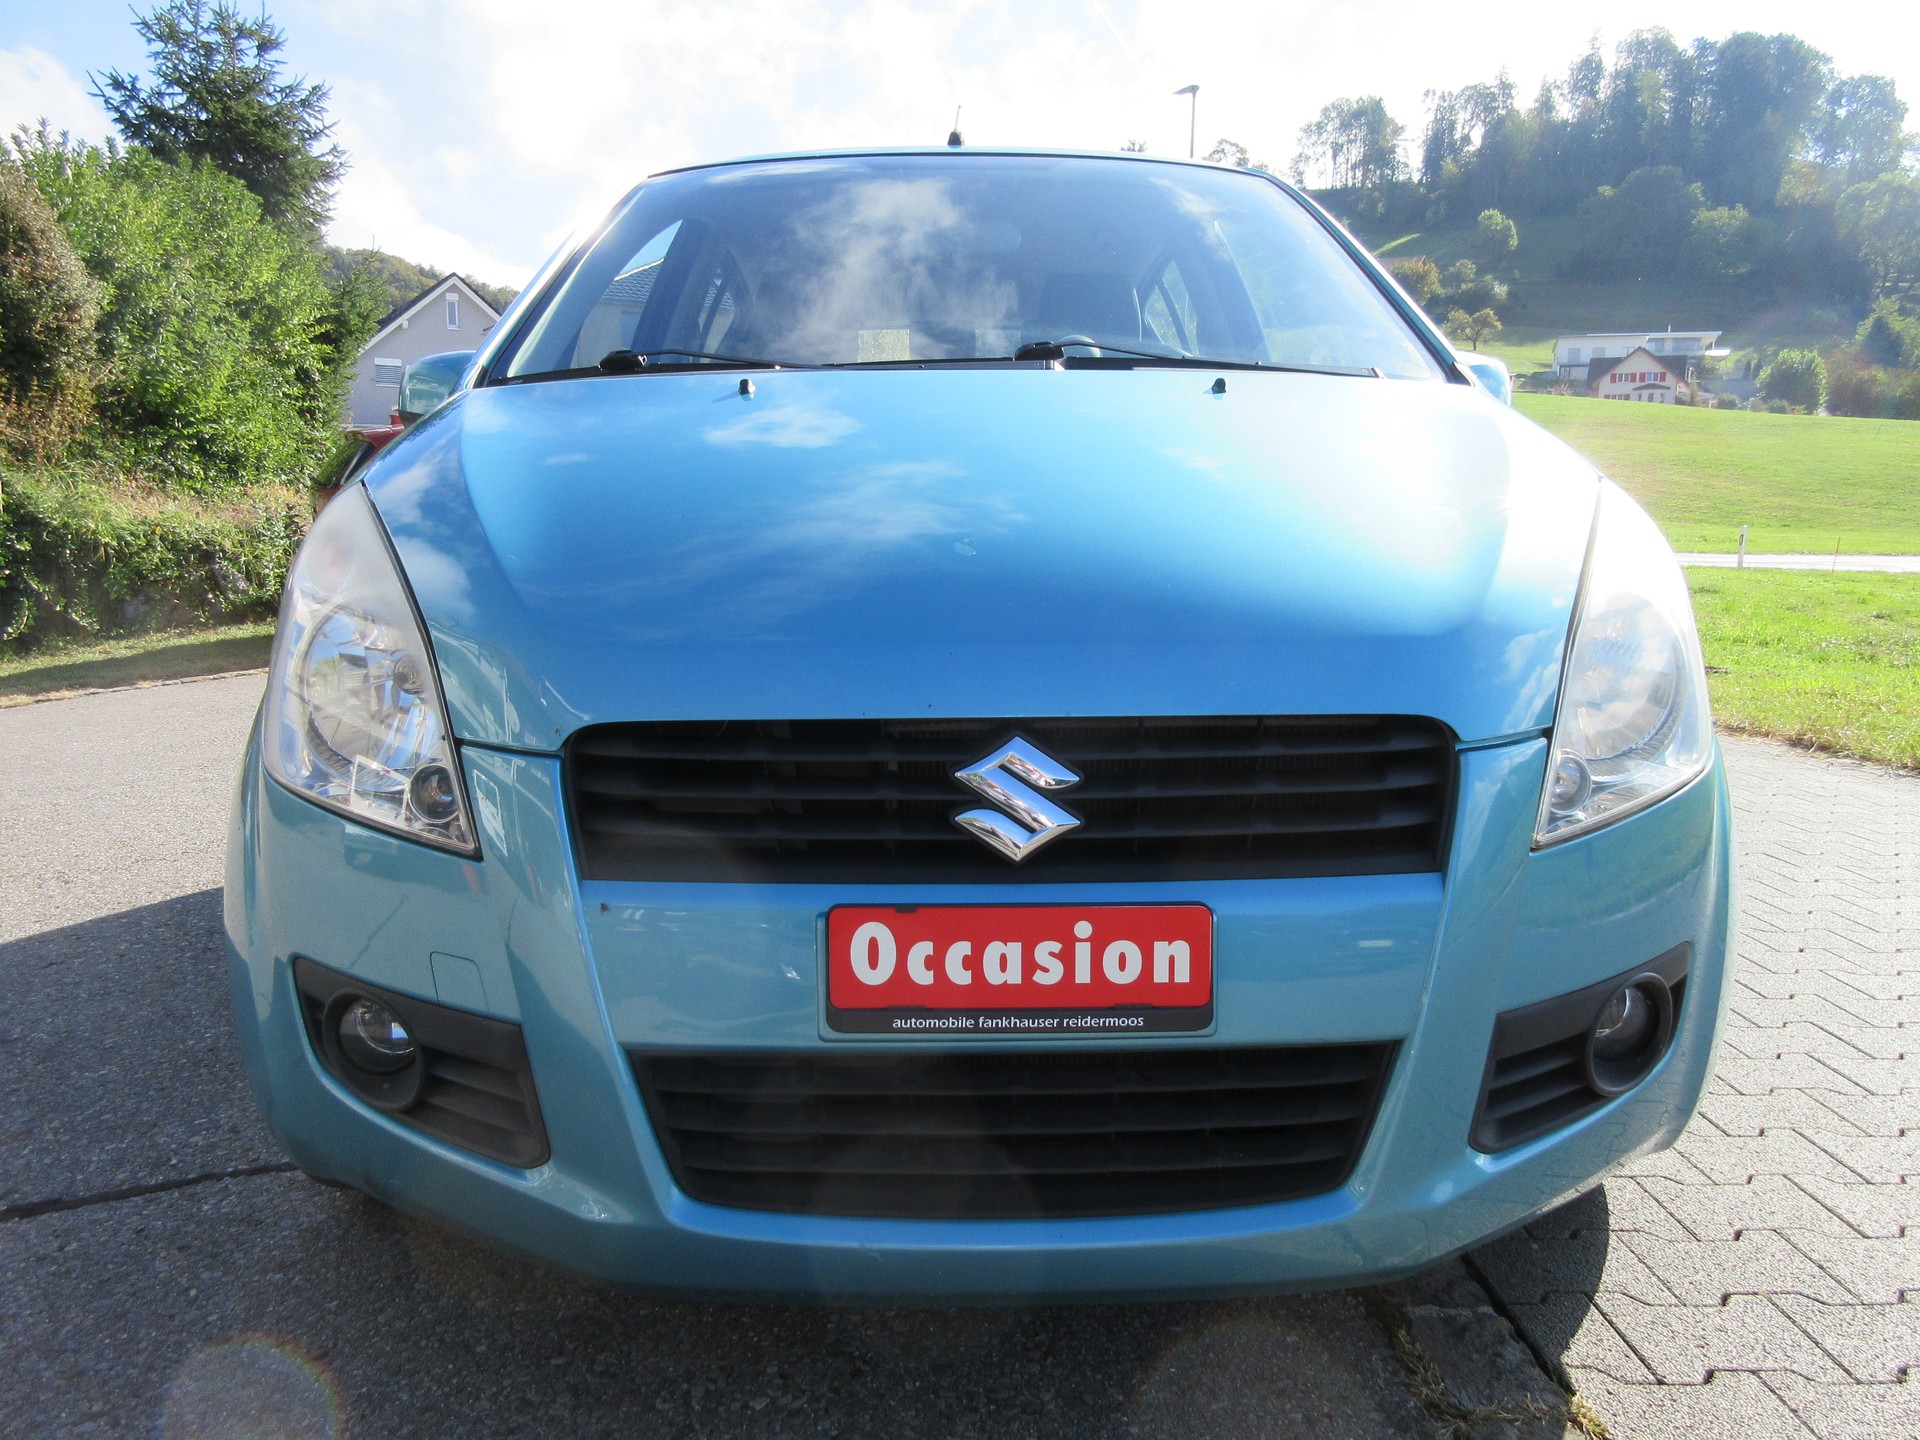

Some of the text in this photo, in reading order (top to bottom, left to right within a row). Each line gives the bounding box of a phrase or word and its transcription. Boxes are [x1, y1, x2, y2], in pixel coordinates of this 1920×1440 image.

[850, 920, 1191, 986] Occasion
[892, 1014, 1144, 1029] automobile fankhauser reidermoos
